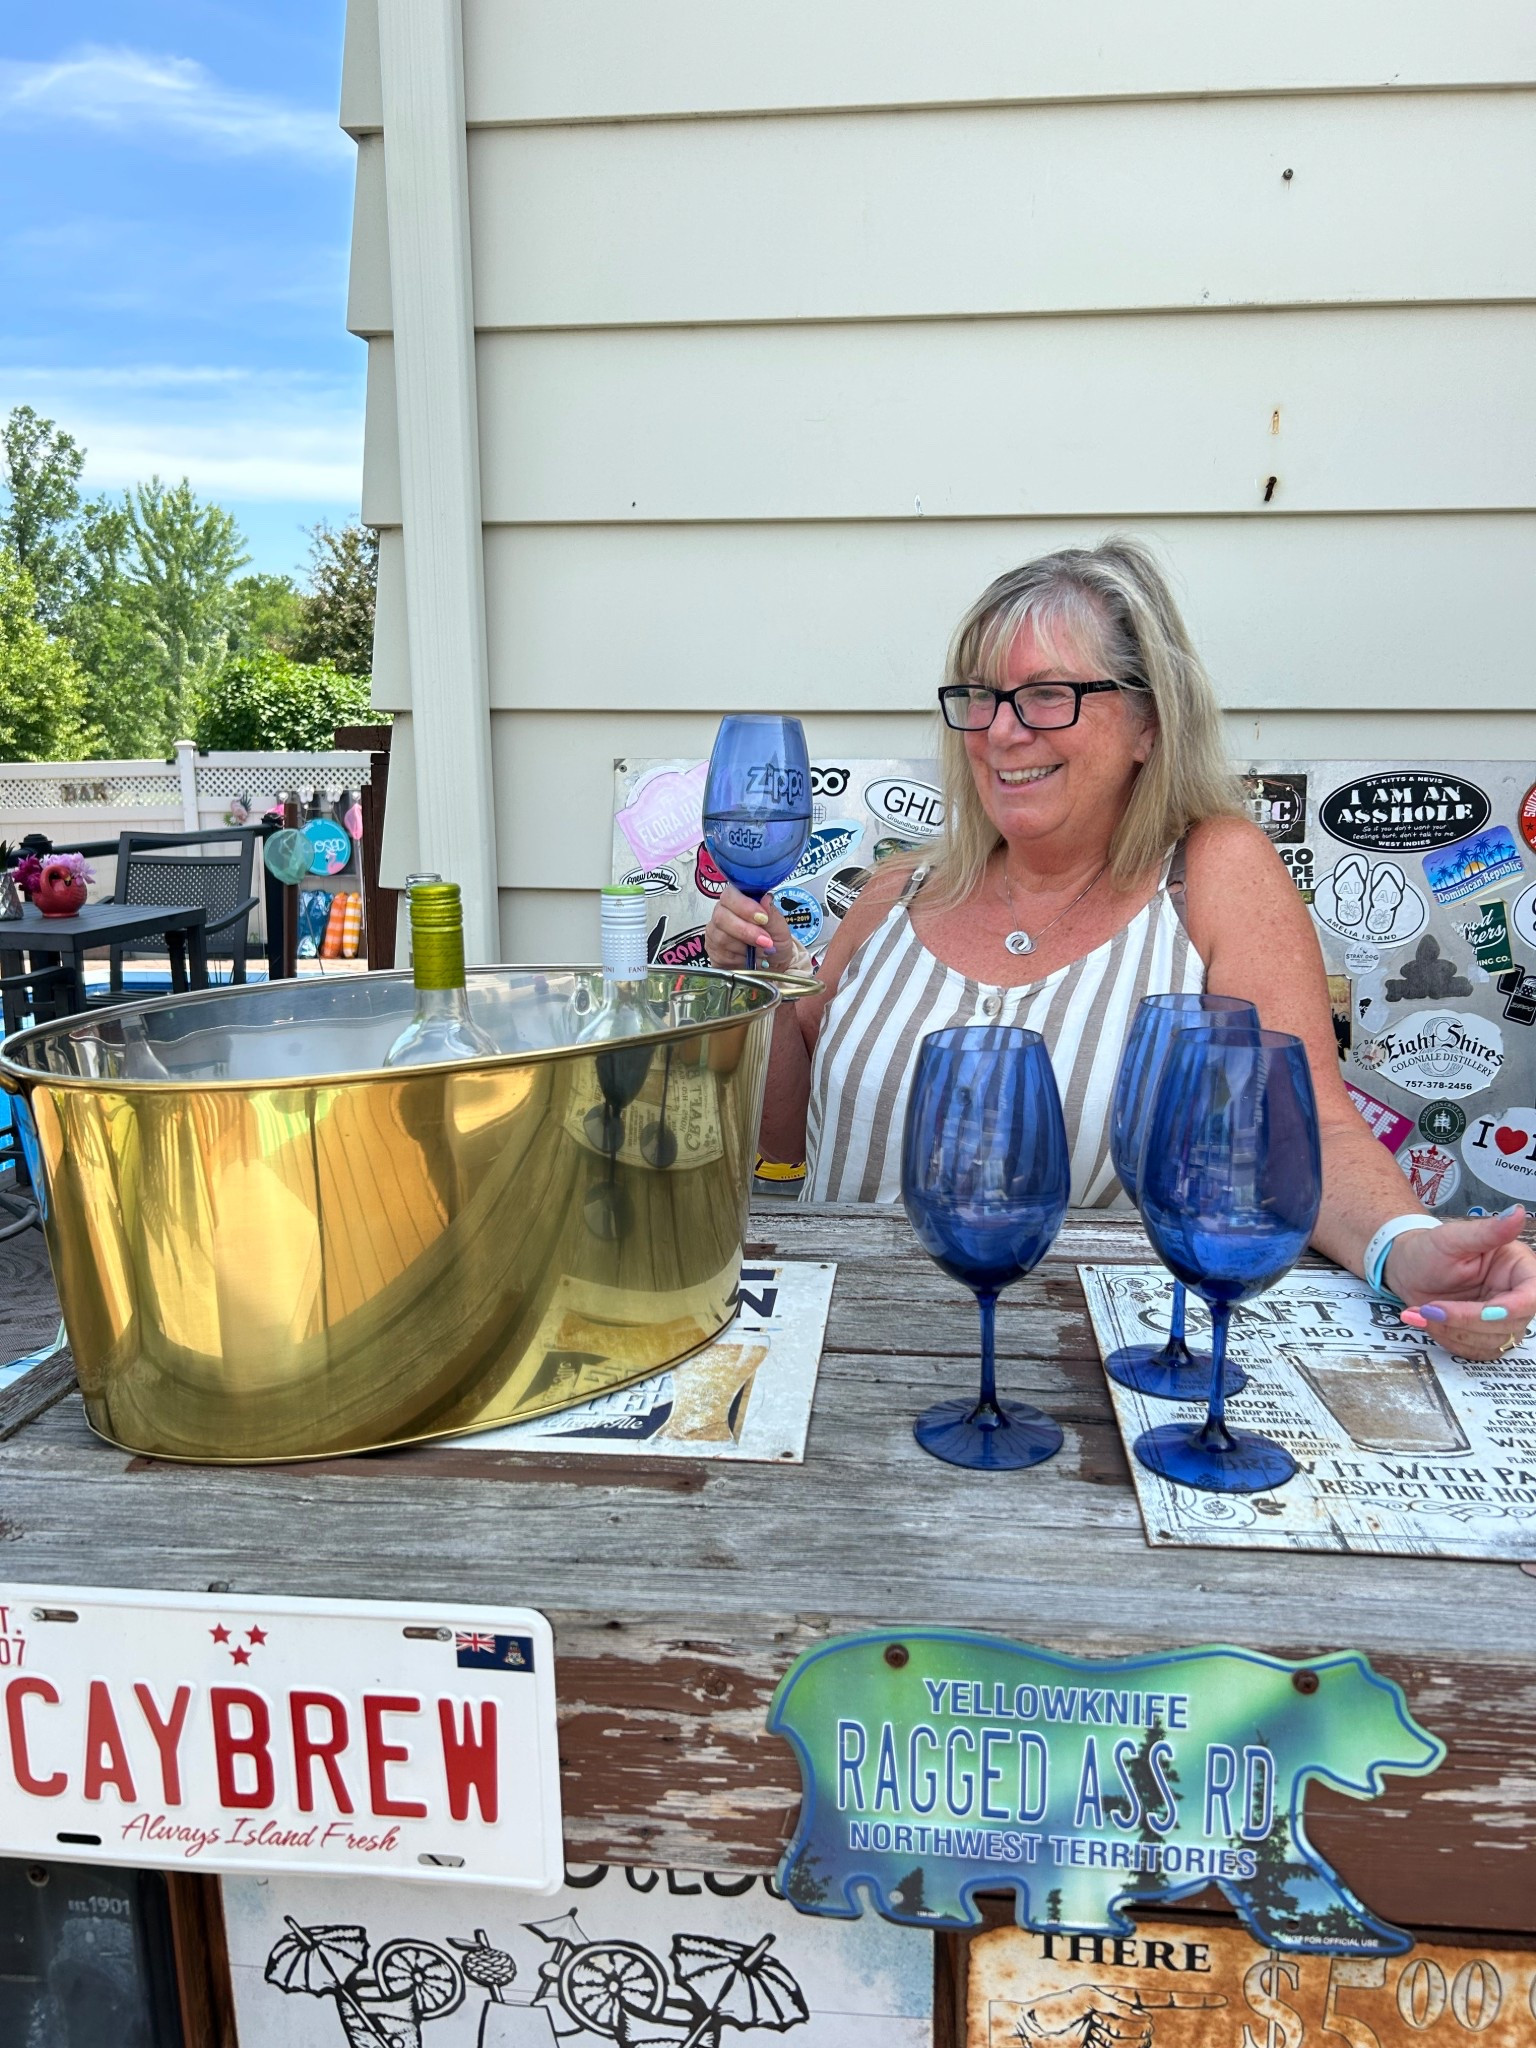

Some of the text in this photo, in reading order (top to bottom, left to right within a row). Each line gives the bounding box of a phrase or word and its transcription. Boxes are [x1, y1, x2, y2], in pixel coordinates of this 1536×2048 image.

[1381, 776, 1406, 784] KITTS
[1417, 776, 1443, 784] NEVIS
[884, 786, 945, 826] GHD
[1350, 786, 1461, 805] I AM AN
[886, 813, 934, 834] Groundhog Day
[1336, 804, 1474, 824] ASSHOLE
[638, 811, 683, 848] FLORA
[1352, 832, 1379, 840] feelings
[810, 833, 852, 856] TURK
[1403, 839, 1431, 847] INDIES
[783, 865, 807, 883] URKS
[1292, 866, 1314, 878] PE
[1437, 862, 1522, 903] Dominican Republic
[1326, 918, 1358, 938] AMELIA
[1379, 1024, 1504, 1067] Eight Shires
[1353, 1051, 1384, 1071] DISTILLERY
[1391, 1052, 1495, 1078] COLONIALE DISTILLERY
[1404, 1080, 1473, 1091] 757-378-2456
[1299, 1327, 1354, 1338] H2O
[604, 1415, 644, 1430] Ale
[1265, 1410, 1292, 1418] WITH
[1330, 1459, 1365, 1478] IT
[1377, 1460, 1488, 1483] WITH
[1316, 1478, 1432, 1498] RESPECT
[1434, 1484, 1493, 1501] THE
[922, 1677, 1189, 1730] YELLOWKNIFE
[5, 1676, 499, 1823] CAYBREW
[836, 1719, 1277, 1842] RAGGED ASS RD
[121, 1812, 400, 1858] Always Island Fresh
[848, 1820, 1259, 1881] NORTHWEST TERRITORIES
[1031, 1930, 1212, 1973] THERE
[1304, 1936, 1321, 1944] FOR
[1323, 1937, 1360, 1947] OFFICIAL
[1361, 1938, 1379, 1948] USE
